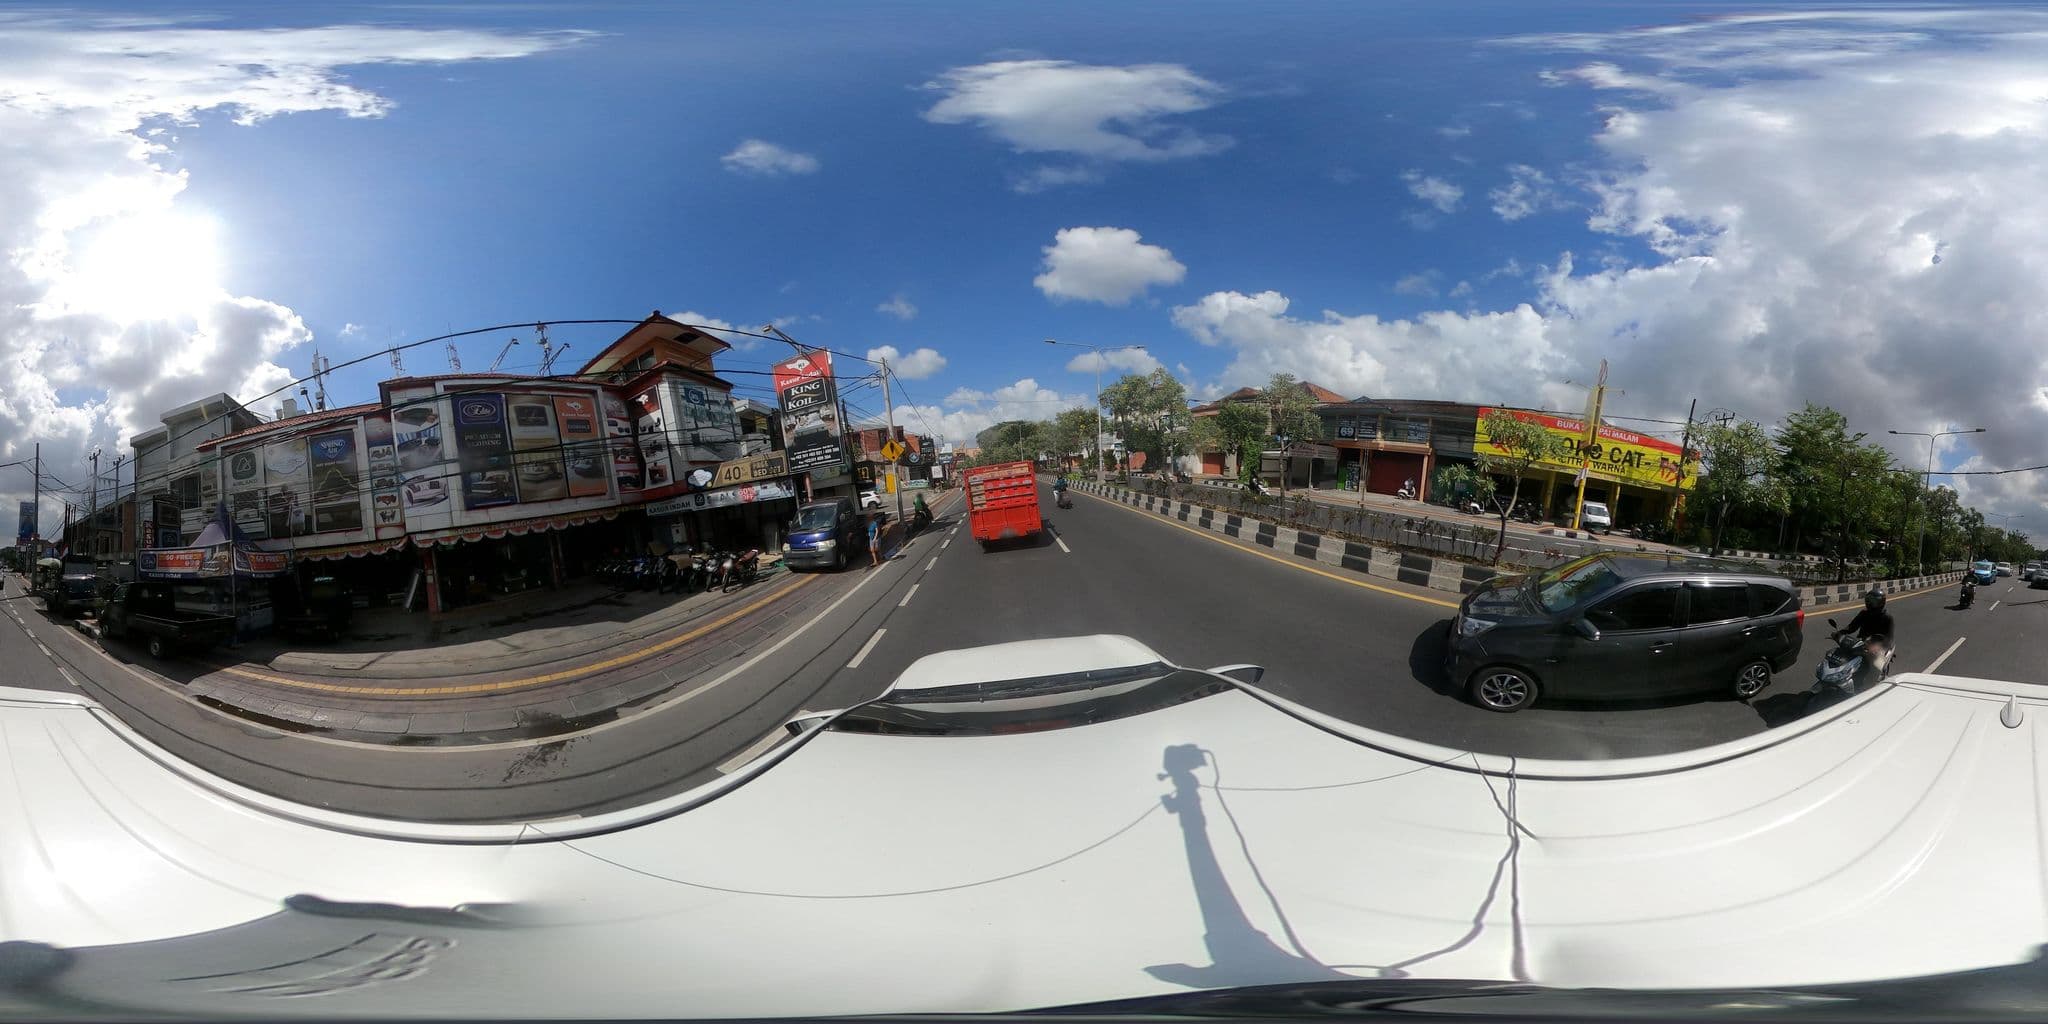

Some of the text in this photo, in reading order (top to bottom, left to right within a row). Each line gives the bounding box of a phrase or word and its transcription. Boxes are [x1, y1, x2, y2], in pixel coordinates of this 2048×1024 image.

[791, 381, 820, 396] KING
[788, 397, 815, 410] KOIL
[1340, 427, 1355, 437] 69
[1557, 419, 1580, 433] BUKA
[1612, 429, 1639, 445] MALAM
[1593, 461, 1625, 475] WARNA
